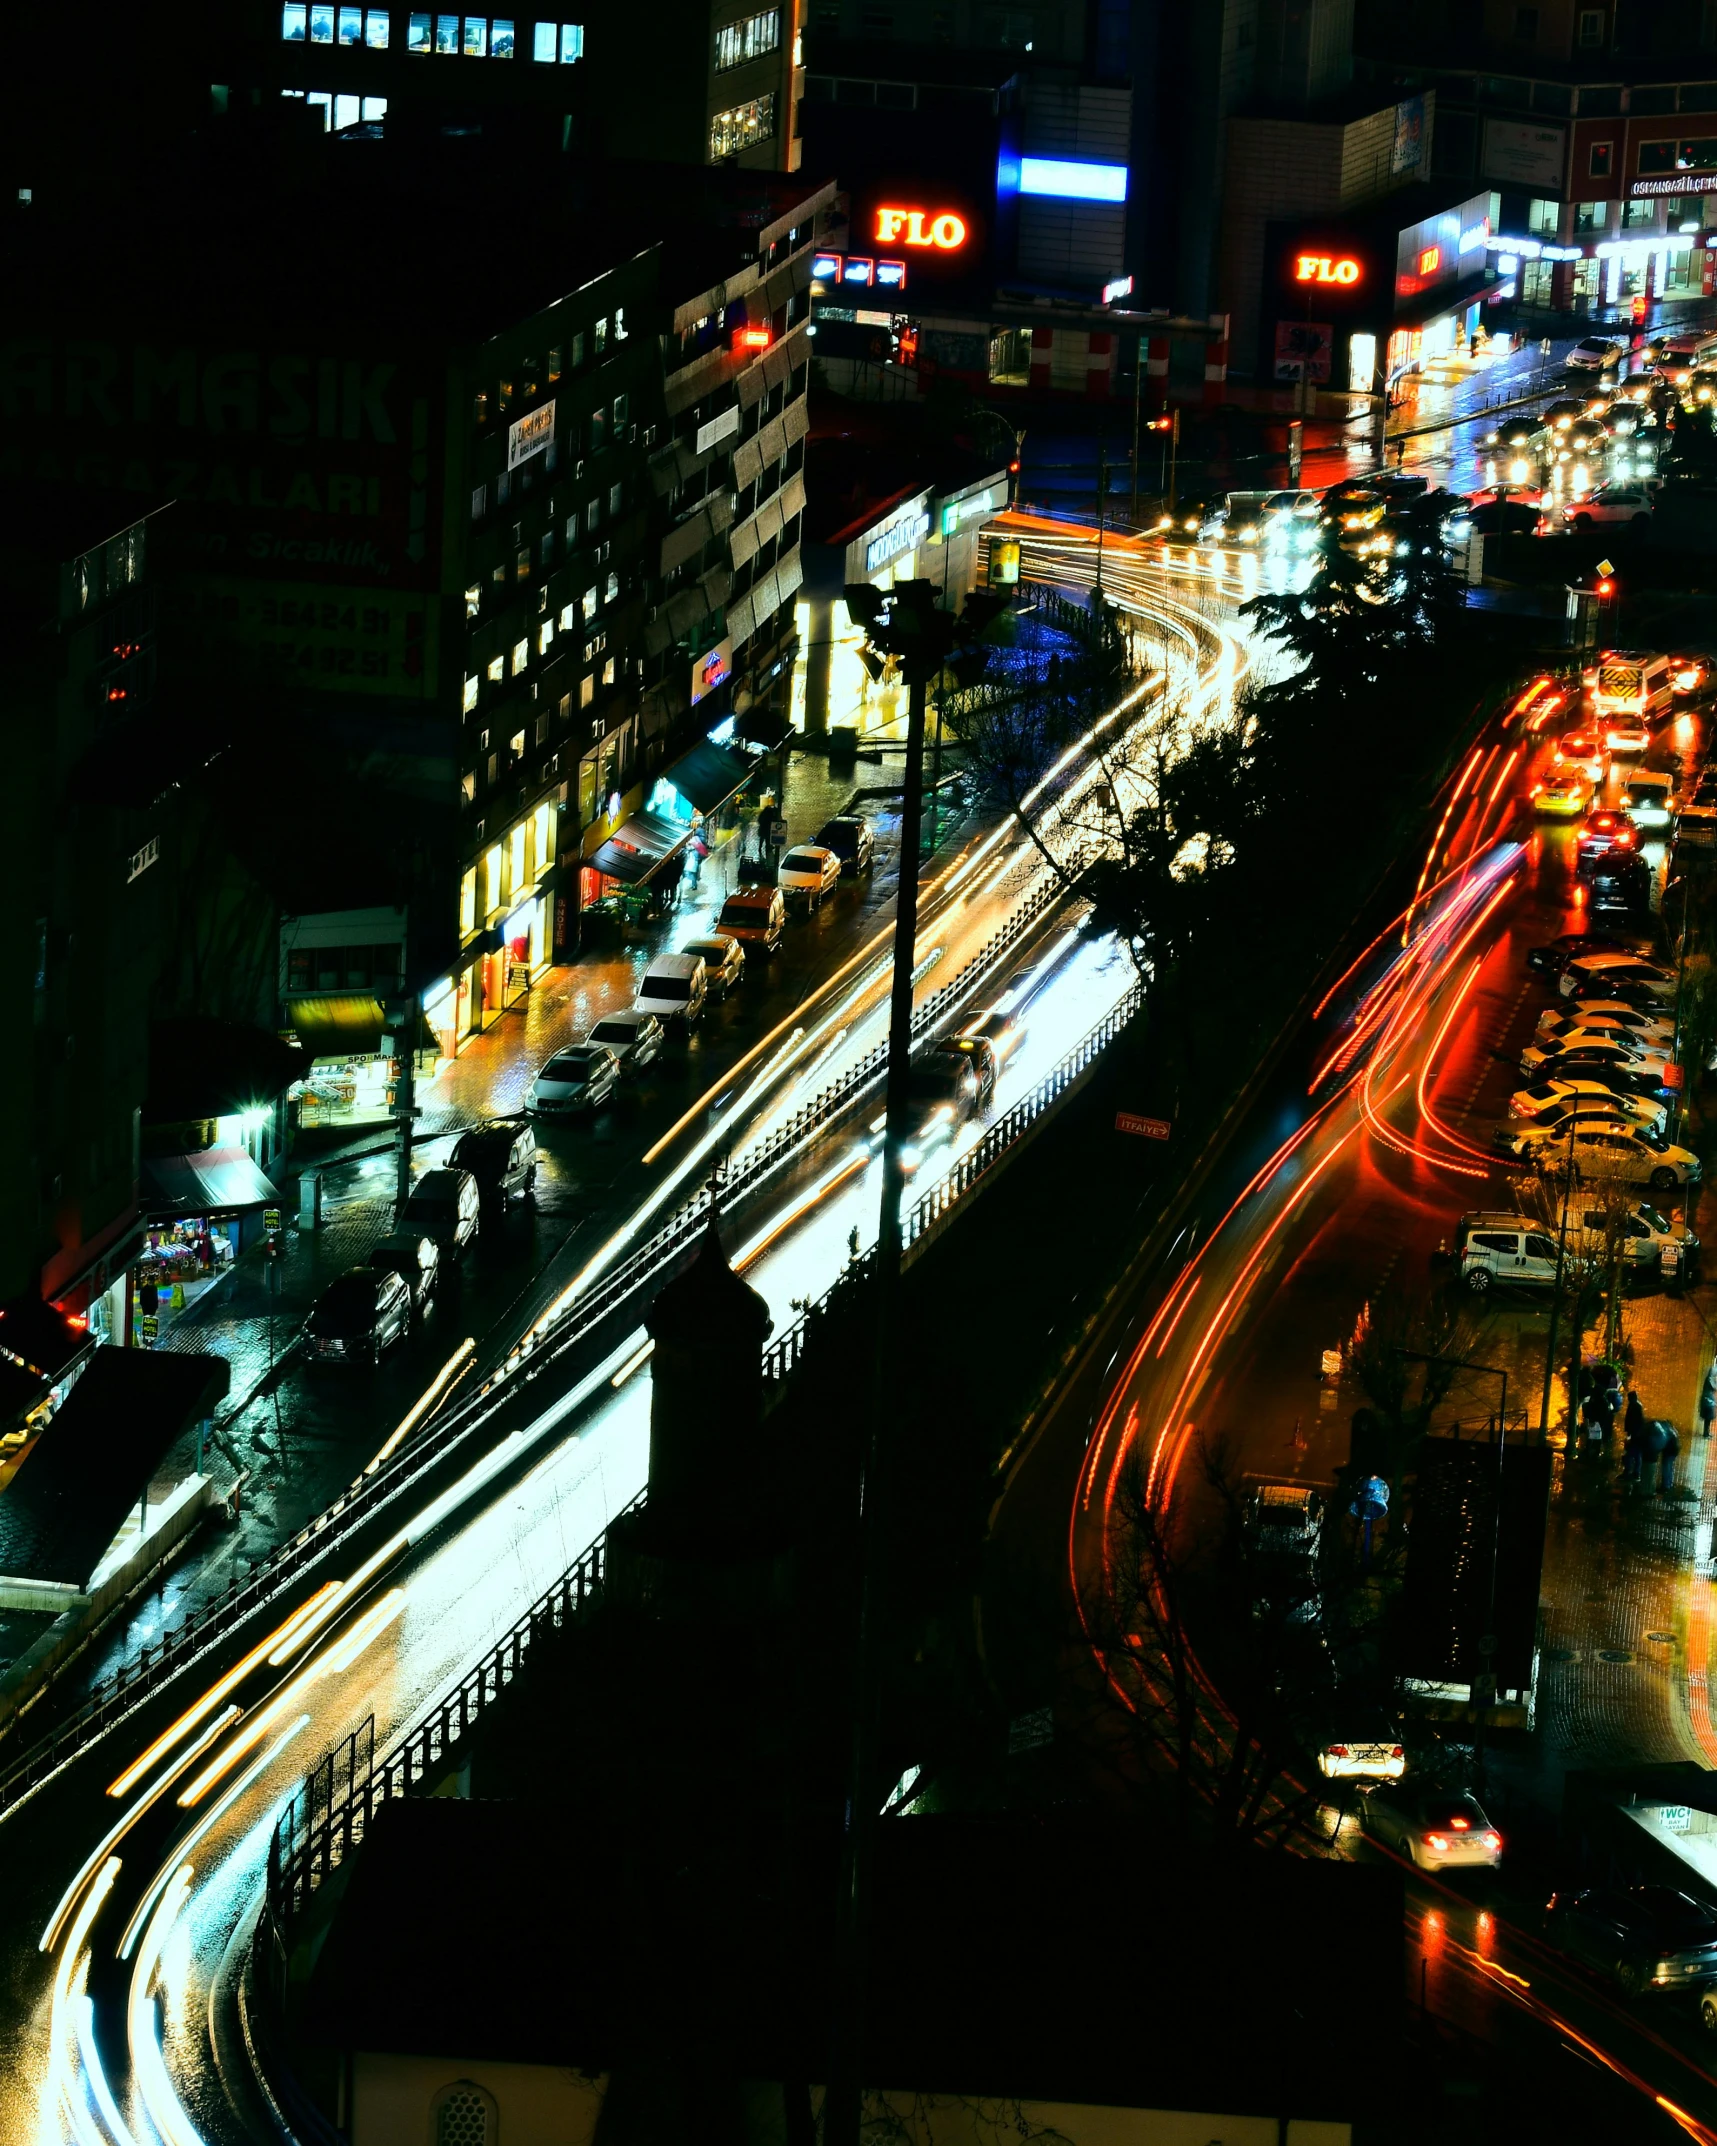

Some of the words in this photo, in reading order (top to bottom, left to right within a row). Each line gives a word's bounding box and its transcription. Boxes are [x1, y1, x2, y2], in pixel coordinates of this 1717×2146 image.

[875, 208, 966, 249] FLO
[1296, 257, 1359, 285] FLO
[1121, 1118, 1159, 1135] İTFAİYE
[1666, 1807, 1686, 1818] WC
